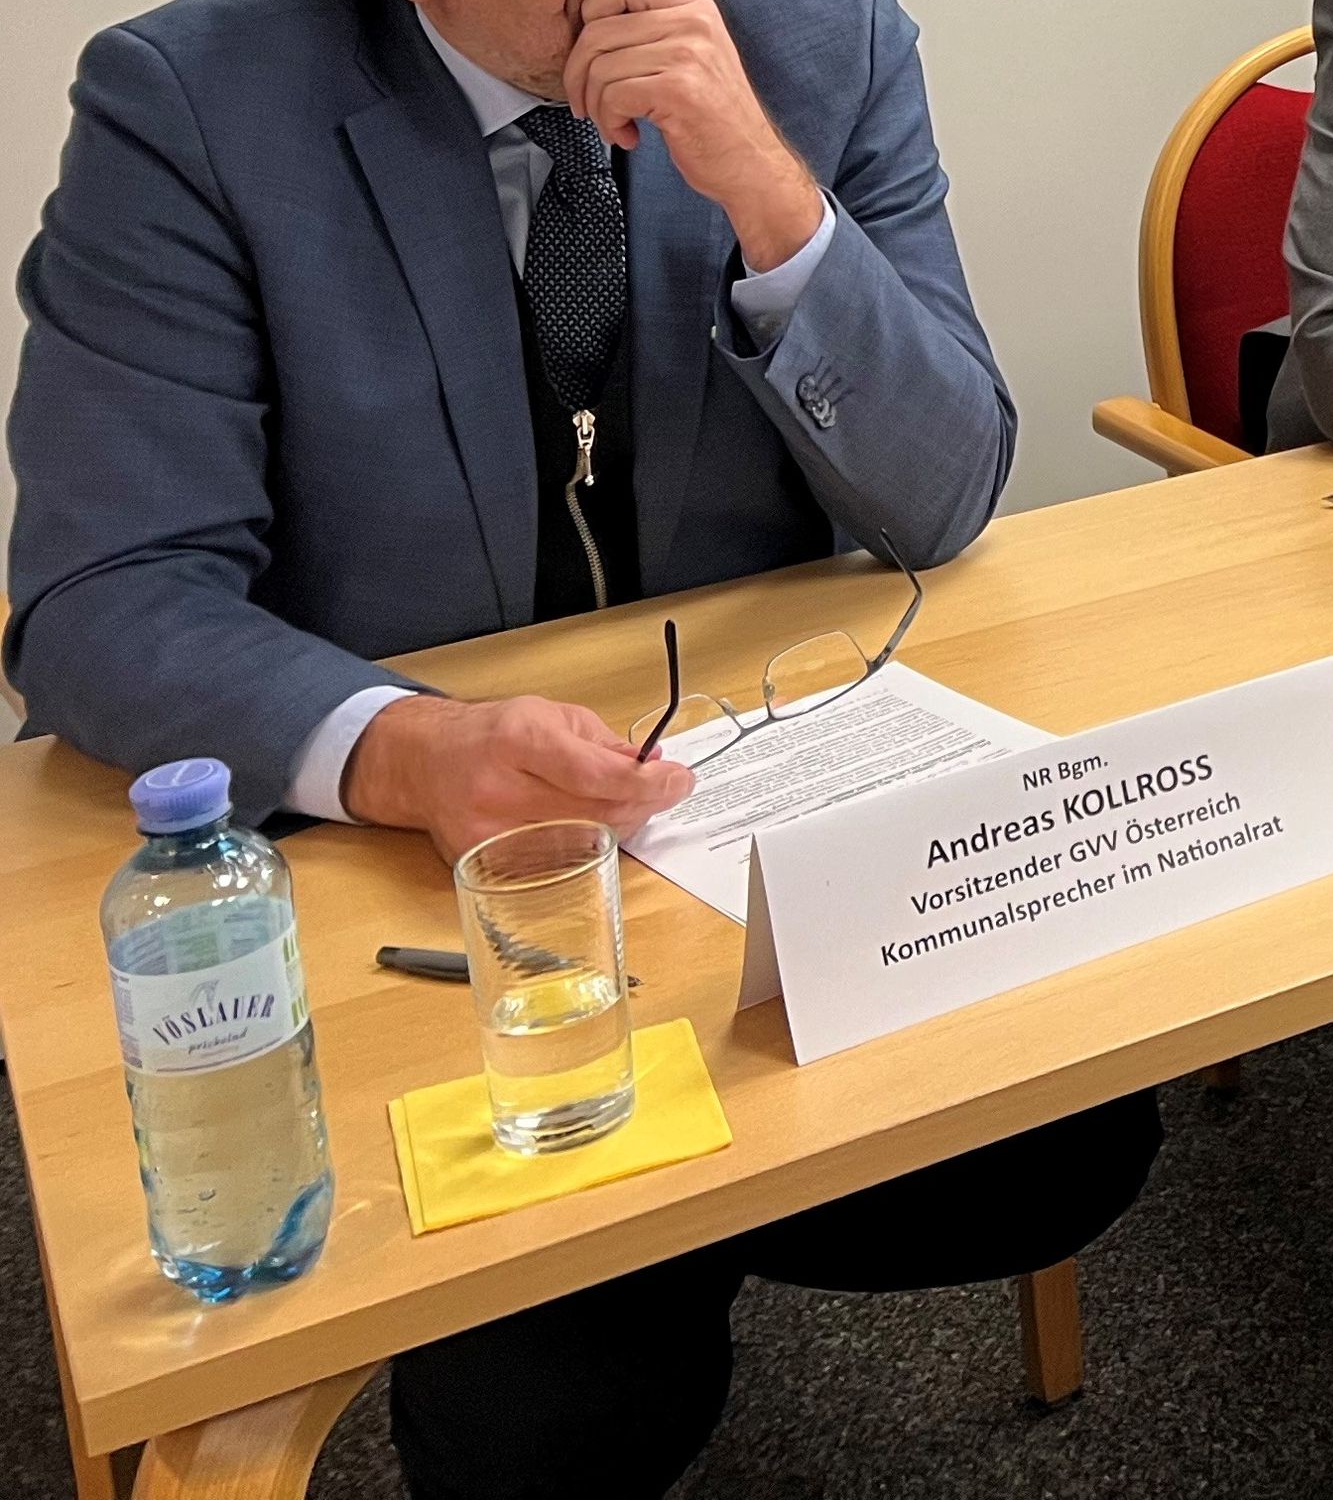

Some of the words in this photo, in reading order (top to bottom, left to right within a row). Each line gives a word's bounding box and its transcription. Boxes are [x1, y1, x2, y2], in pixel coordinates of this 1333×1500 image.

[926, 806, 1056, 868] Andreas
[1062, 754, 1213, 824] KOLLROSS
[1021, 766, 1053, 791] NR
[1057, 751, 1109, 781] Bgm.
[880, 871, 1116, 967] Kommunalsprecher
[1122, 858, 1152, 883] im
[1158, 815, 1284, 873] Nationalrat
[911, 851, 1063, 916] Vorsitzender
[1069, 831, 1119, 864] GVV
[1126, 791, 1241, 845] Österreich
[152, 993, 275, 1046] VÖSLAUER
